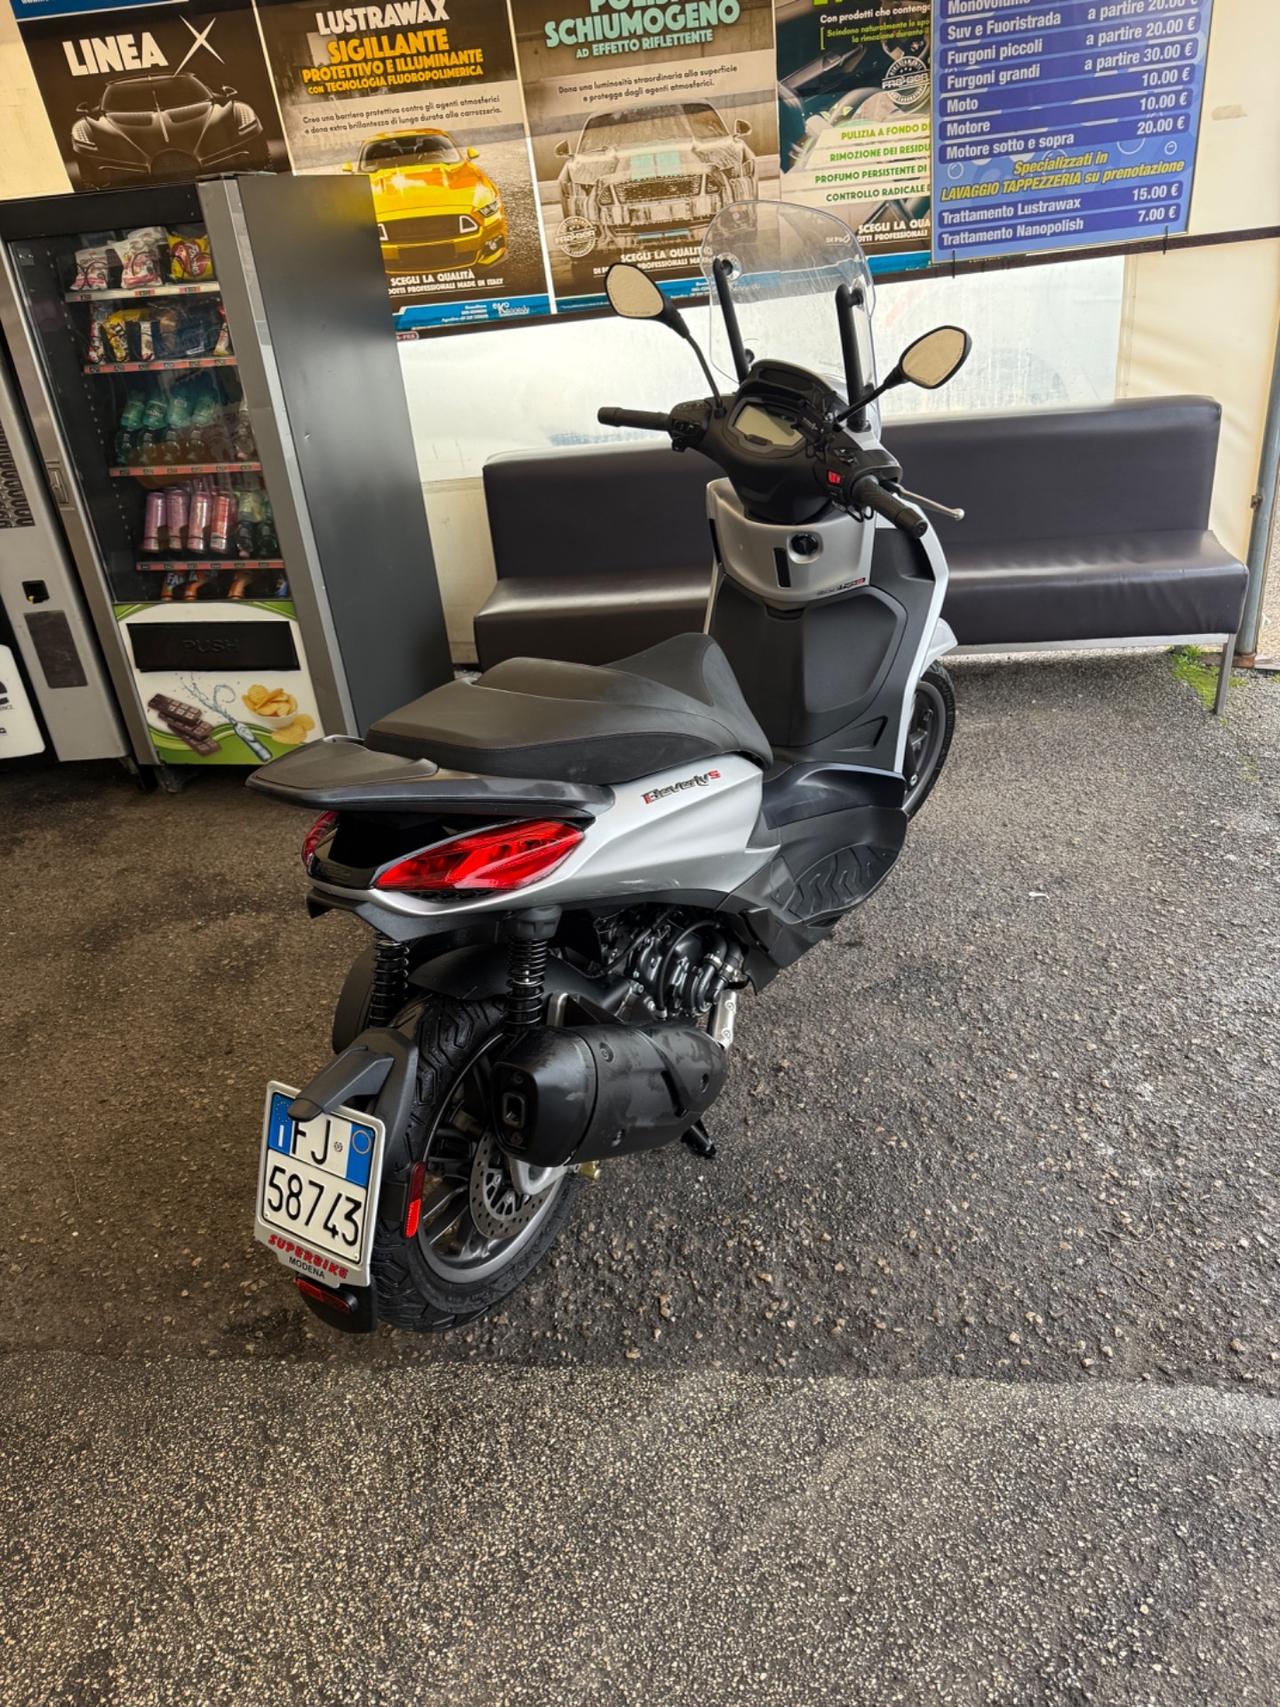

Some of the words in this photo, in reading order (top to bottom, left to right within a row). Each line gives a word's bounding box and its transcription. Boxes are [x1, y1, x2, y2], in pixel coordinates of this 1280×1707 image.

[315, 0, 450, 35] LUSTRAWAX
[820, 14, 838, 23] Con
[839, 8, 874, 23] prodotti
[874, 7, 891, 16] che
[1088, 8, 1096, 20] a
[1100, 0, 1145, 21] partire
[544, 0, 740, 48] SCHIUMOGENO
[947, 25, 972, 40] Suv
[975, 24, 983, 36] e
[987, 11, 1061, 34] Fuoristrada
[1086, 34, 1094, 45] a
[1098, 25, 1142, 47] partire
[1146, 18, 1183, 37] 20.00
[1188, 16, 1196, 31] €
[62, 32, 169, 76] LINEA
[174, 15, 224, 78] X
[327, 28, 449, 63] SIGILLANTE
[576, 48, 589, 58] AD
[592, 39, 640, 56] EFFETTO
[641, 29, 713, 50] RIFLETTENTE
[947, 45, 996, 65] Furgoni
[1000, 38, 1043, 60] piccoli
[302, 60, 384, 83] PROTETTIVO
[385, 59, 394, 73] E
[395, 48, 484, 71] ILLUMINANTE
[1084, 59, 1093, 70] a
[1096, 51, 1140, 72] partire
[1143, 44, 1181, 62] 30.00
[1185, 42, 1193, 56] €
[325, 75, 388, 93] TECNOLOGIA
[387, 65, 484, 85] FLUOROPOLIMERICA
[558, 86, 577, 94] Dona
[579, 83, 593, 91] una
[634, 72, 683, 85] straordinaria
[684, 69, 699, 78] alla
[699, 64, 738, 77] superficie
[947, 70, 995, 90] Furgoni
[998, 64, 1040, 85] grandi
[1142, 69, 1178, 87] 10.00
[1182, 67, 1190, 81] €
[589, 92, 623, 103] protegge
[624, 88, 644, 98] dagli
[645, 85, 669, 95] agenti
[947, 98, 978, 113] Moto
[1140, 94, 1175, 111] 10.00
[1180, 92, 1188, 106] €
[303, 116, 320, 124] Crea
[335, 111, 365, 120] barriera
[365, 107, 400, 119] protettiva
[425, 102, 434, 112] gli
[436, 100, 459, 111] agenti
[459, 96, 500, 107] atmosferici
[310, 125, 328, 134] dona
[329, 123, 348, 132] extra
[348, 118, 389, 130] brillantezza
[390, 117, 397, 125] di
[398, 116, 419, 126] lunga
[420, 113, 444, 122] durata
[445, 110, 459, 119] alla
[841, 130, 876, 140] PULIZIA
[878, 128, 885, 136] A
[886, 124, 919, 136] FONDO
[947, 120, 990, 136] Motore
[1137, 118, 1173, 135] 20.00
[1177, 116, 1185, 129] €
[830, 149, 881, 162] RIMOZIONE
[883, 147, 898, 156] DEI
[947, 144, 989, 160] Motore
[993, 139, 1024, 153] sotto
[1028, 139, 1035, 149] e
[1039, 134, 1074, 149] sopra
[815, 171, 860, 184] PROFUMO
[862, 165, 916, 179] PERSISTENTE
[917, 164, 927, 173] DI
[1014, 152, 1092, 176] Specializzati
[1095, 151, 1108, 164] in
[826, 189, 880, 202] CONTROLLO
[882, 184, 926, 196] RADICALE
[941, 182, 999, 201] LAVAGGIO
[1002, 172, 1080, 193] TAPPEZZERIA
[1084, 173, 1100, 183] su
[1102, 160, 1185, 184] prenotazione
[1132, 185, 1167, 200] 15.00
[1171, 183, 1179, 196] €
[942, 205, 1014, 224] Trattamento
[1017, 199, 1081, 216] Lustrawax
[1138, 208, 1164, 222] 7.00
[1169, 206, 1176, 218] €
[858, 222, 890, 234] SCEGLI
[894, 221, 907, 230] LA
[875, 230, 928, 241] PROFESSIONALI
[942, 227, 1012, 246] Trattamento
[1016, 218, 1084, 236] Nanopolish
[620, 252, 651, 263] SCEGLI
[654, 250, 666, 259] LA
[671, 246, 712, 259] QUALIT
[390, 275, 420, 286] SCEGLI
[422, 274, 435, 283] LA
[437, 268, 475, 282] QUALITÀ
[407, 282, 456, 293] PROFESSIONALI
[456, 280, 476, 289] MADE
[477, 279, 485, 287] IN
[292, 1119, 331, 1165] FJ
[267, 1165, 362, 1247] 58743
[268, 1234, 349, 1280] SUPERBIKE
[289, 1256, 326, 1279] MODENA
